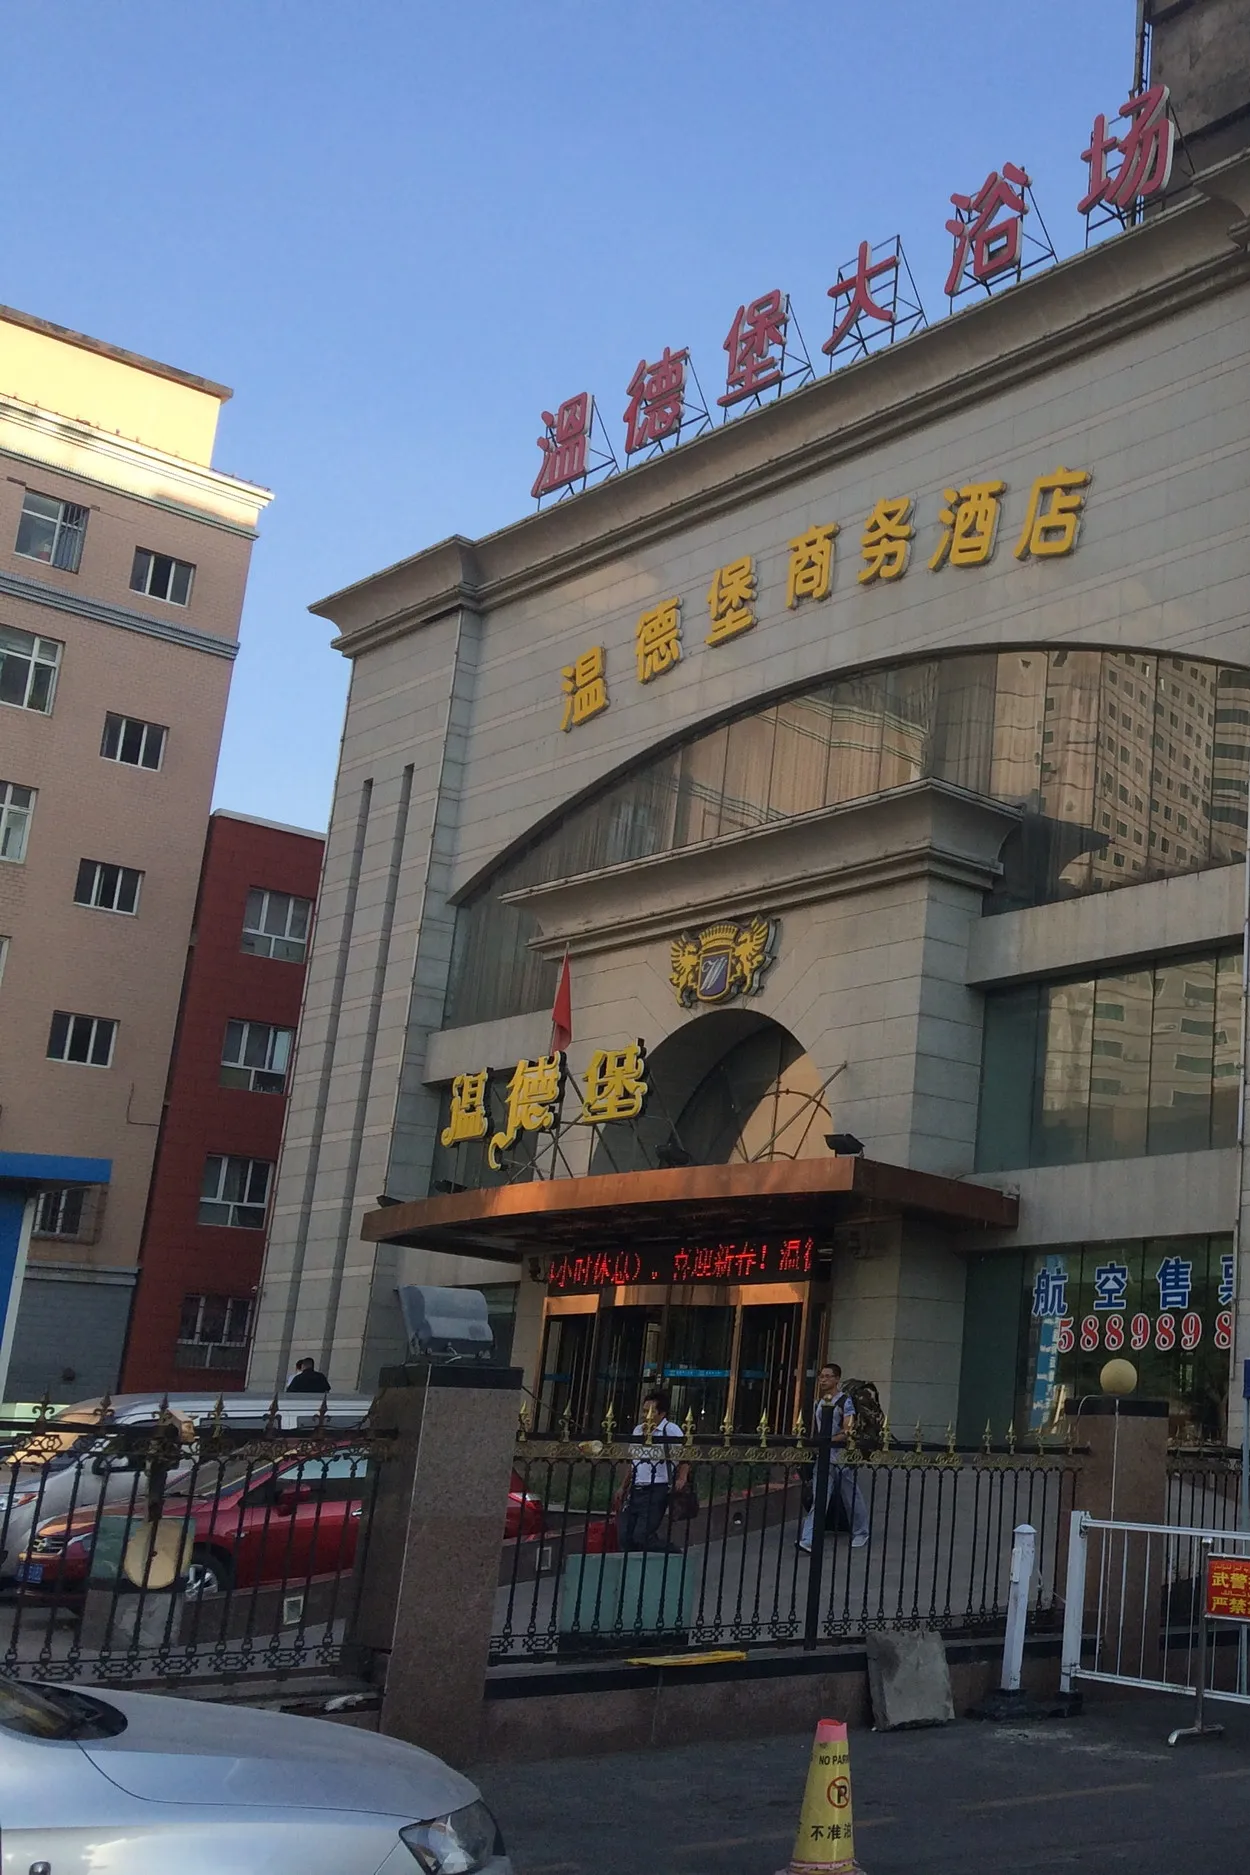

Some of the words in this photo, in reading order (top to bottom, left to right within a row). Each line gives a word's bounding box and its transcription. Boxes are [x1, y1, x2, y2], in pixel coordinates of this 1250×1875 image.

[531, 84, 1175, 498] 温德堡大浴场
[559, 466, 1092, 732] 温德堡商务酒店
[441, 1038, 650, 1170] 温德堡
[1057, 1311, 1232, 1353] 5889898
[818, 1756, 831, 1765] NO
